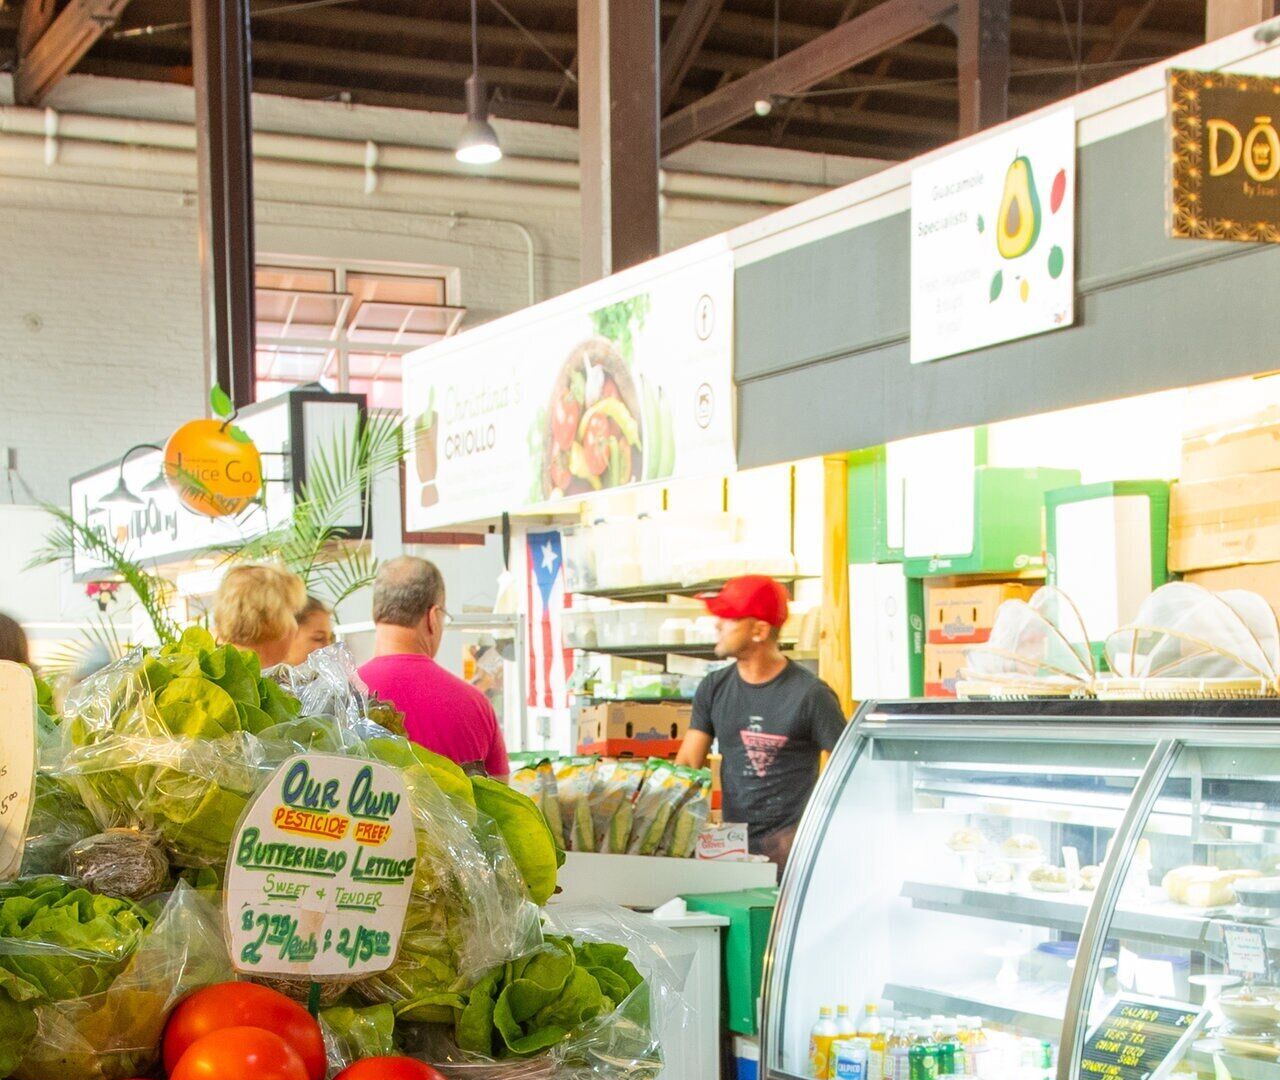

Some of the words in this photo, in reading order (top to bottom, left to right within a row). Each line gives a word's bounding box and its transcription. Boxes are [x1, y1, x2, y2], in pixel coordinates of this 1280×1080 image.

[445, 424, 496, 460] CRIOLLO
[226, 460, 257, 483] Co.
[275, 807, 349, 834] PESTICIDE
[356, 822, 390, 841] FREE!
[236, 828, 348, 873] BUTTERHEAD
[350, 845, 416, 877] LETTUCE
[263, 874, 310, 894] SWEET
[335, 887, 384, 906] TENDER
